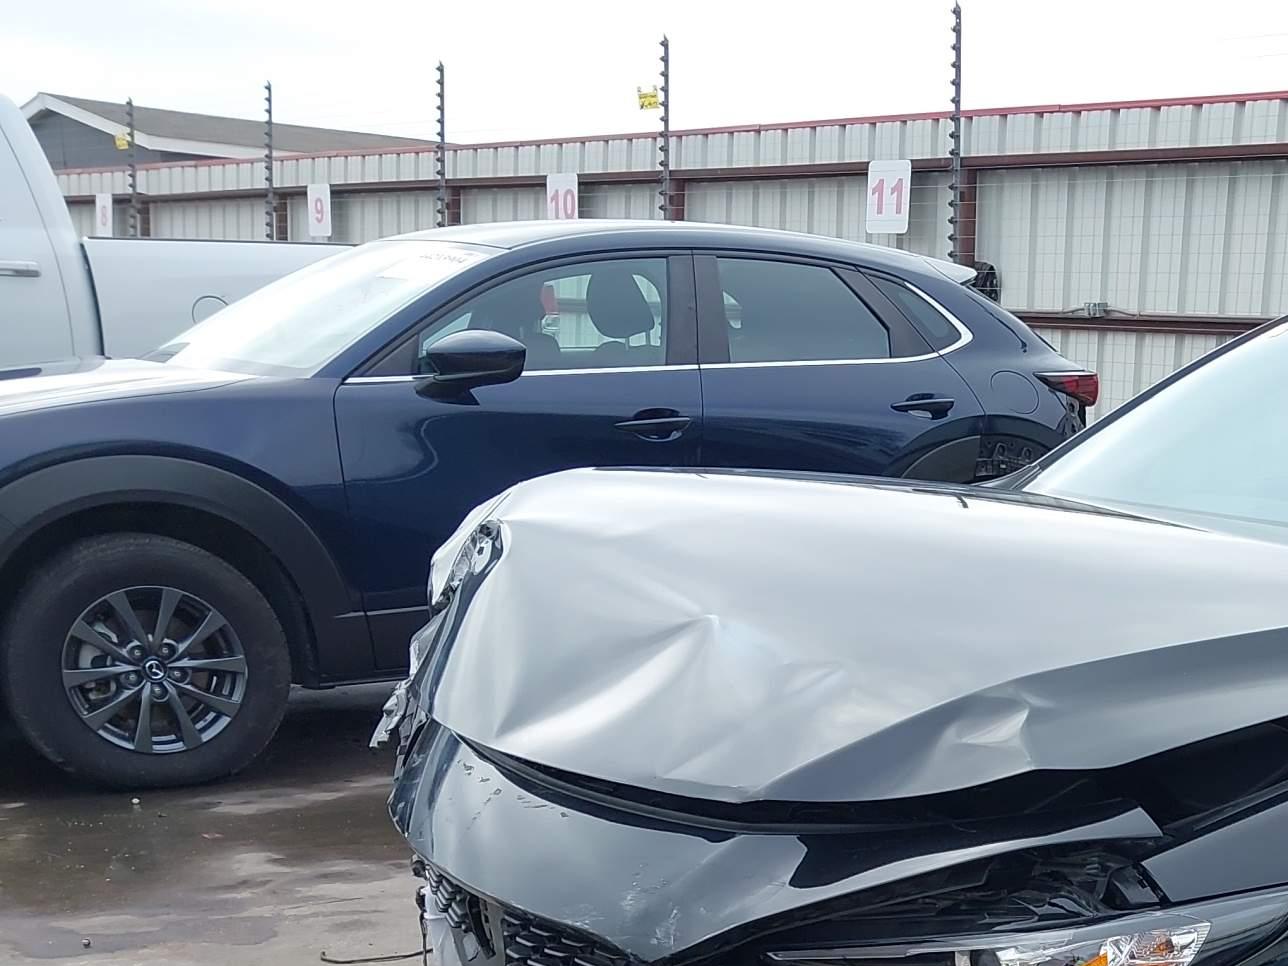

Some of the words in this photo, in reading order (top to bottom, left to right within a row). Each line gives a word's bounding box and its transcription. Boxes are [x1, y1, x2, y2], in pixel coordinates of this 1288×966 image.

[314, 197, 324, 224] 9
[550, 188, 576, 219] 10
[871, 178, 904, 215] 11
